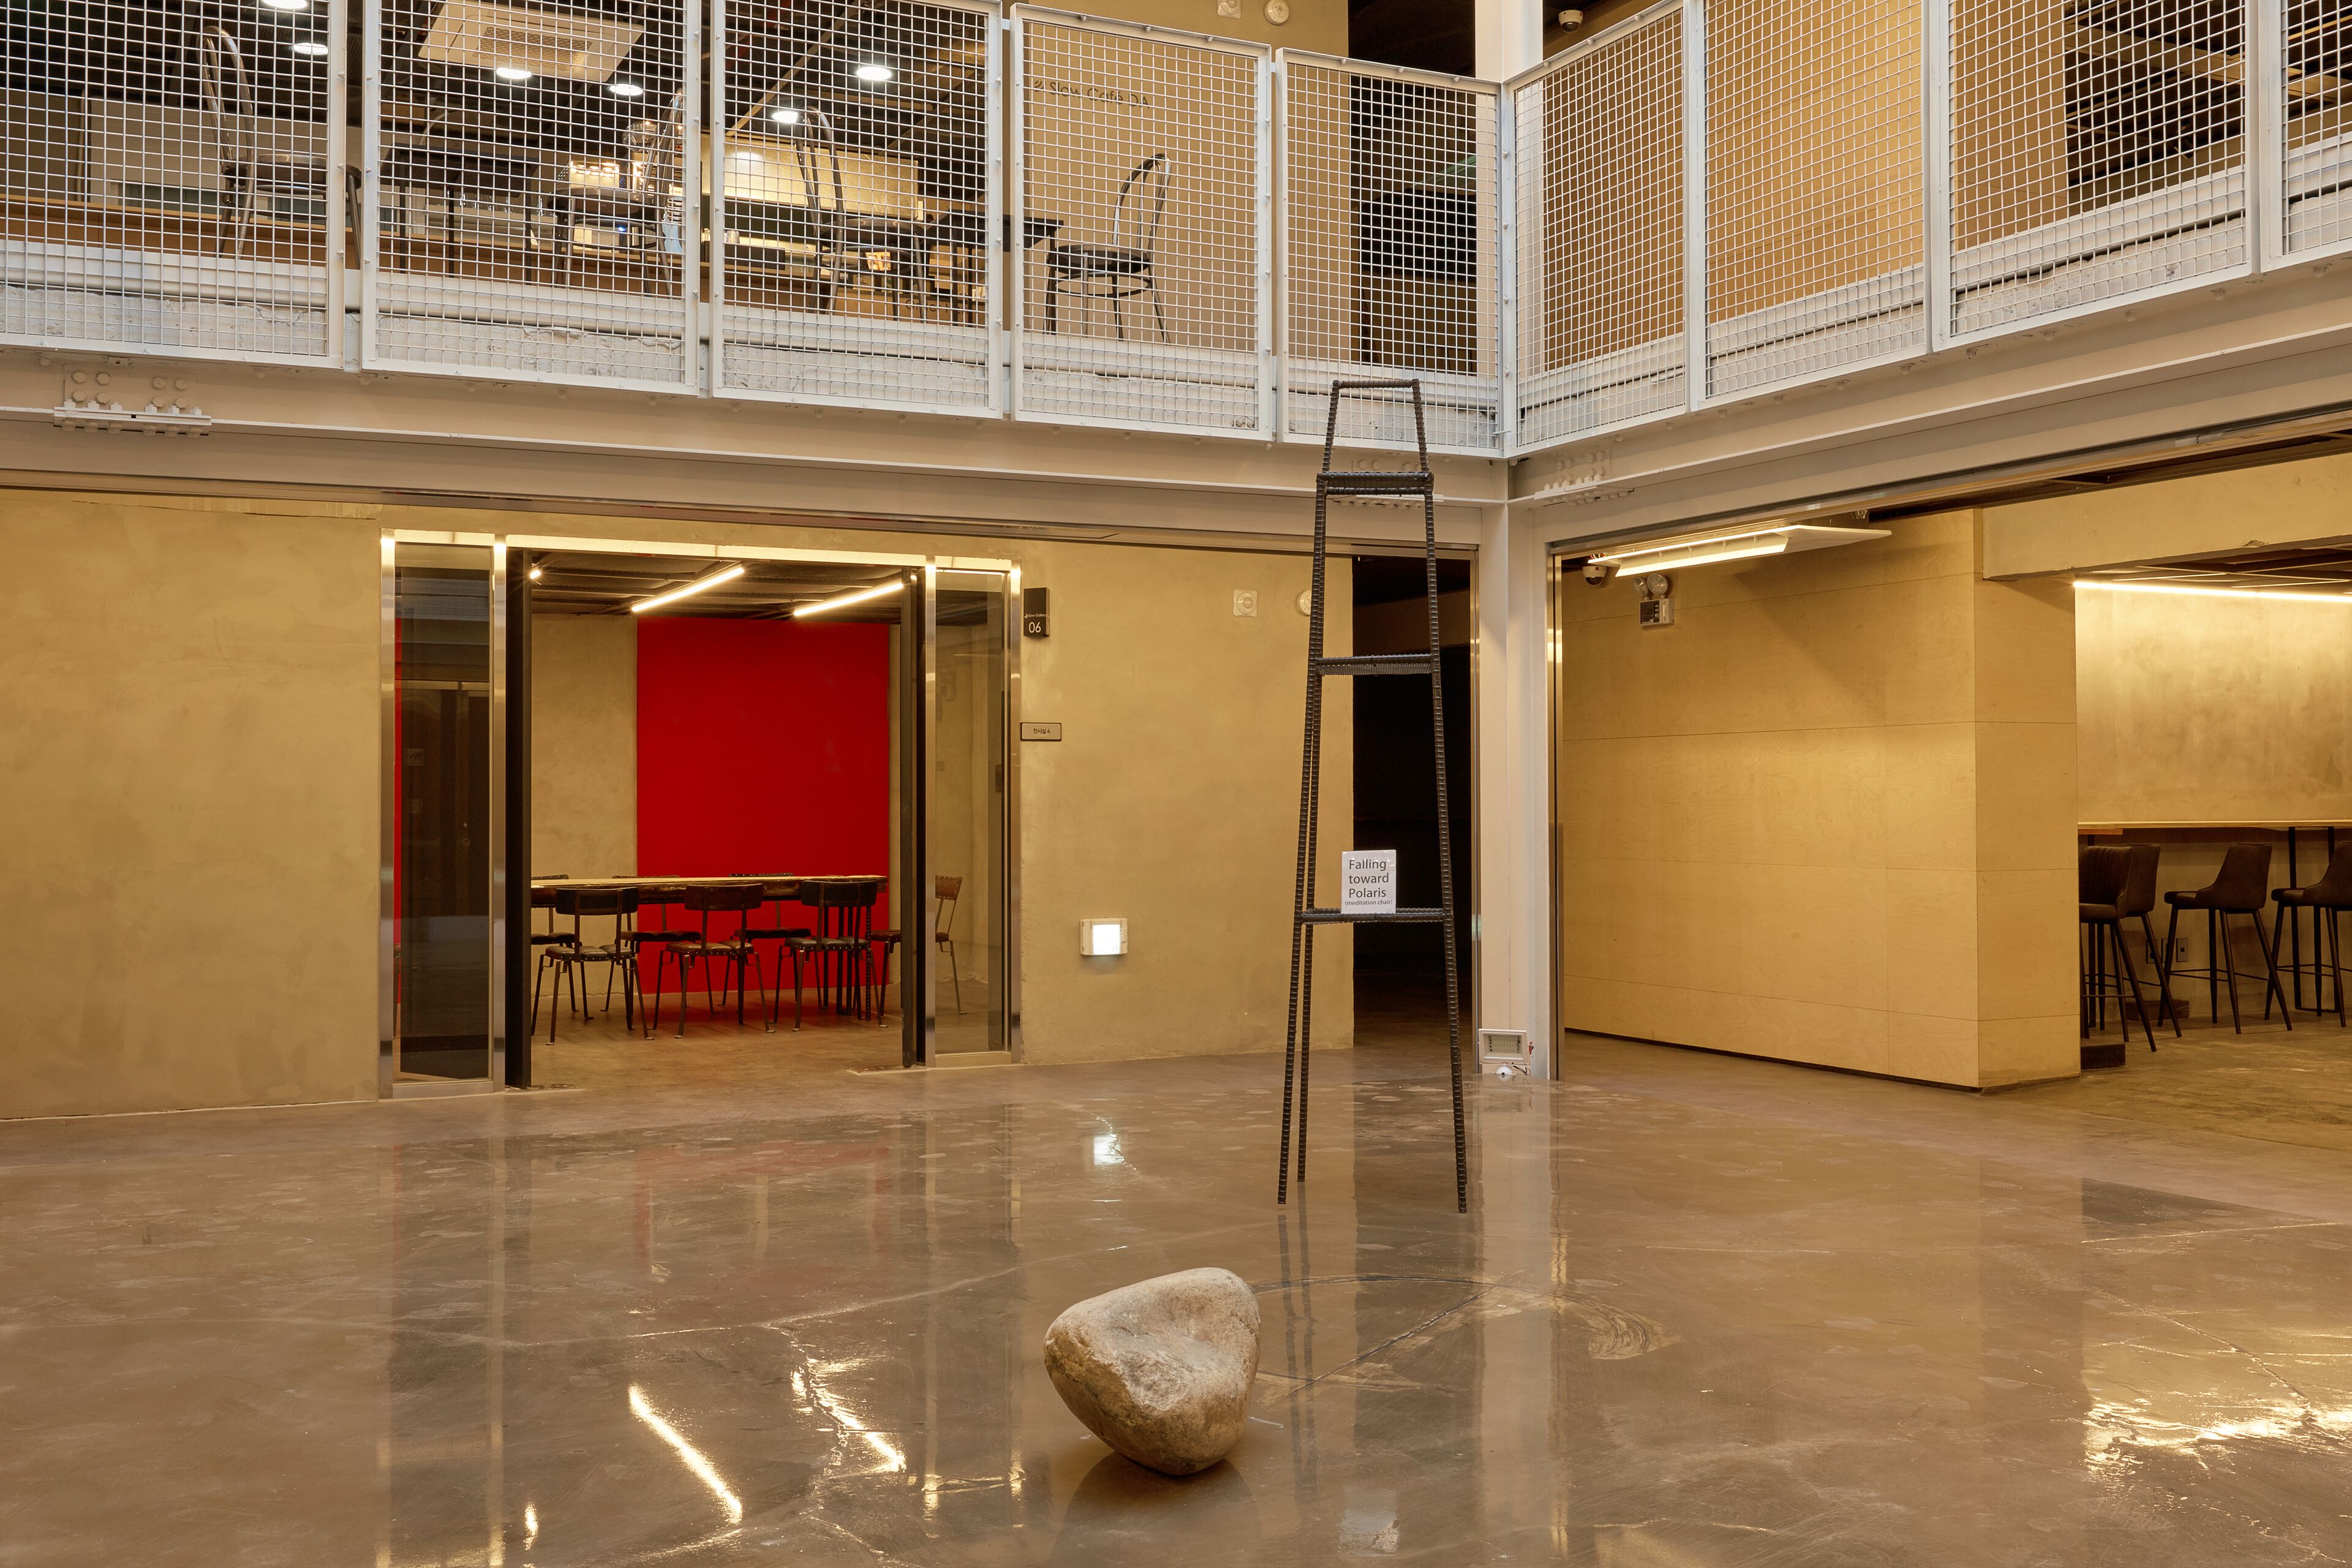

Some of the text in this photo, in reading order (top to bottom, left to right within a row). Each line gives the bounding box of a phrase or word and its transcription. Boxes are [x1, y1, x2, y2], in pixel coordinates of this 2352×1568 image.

[1050, 81, 1083, 99] Slow
[1087, 88, 1123, 105] Café
[1029, 622, 1041, 633] 06
[1349, 859, 1386, 871] Falling
[1349, 873, 1389, 884] toward
[1349, 888, 1386, 898] Polaris
